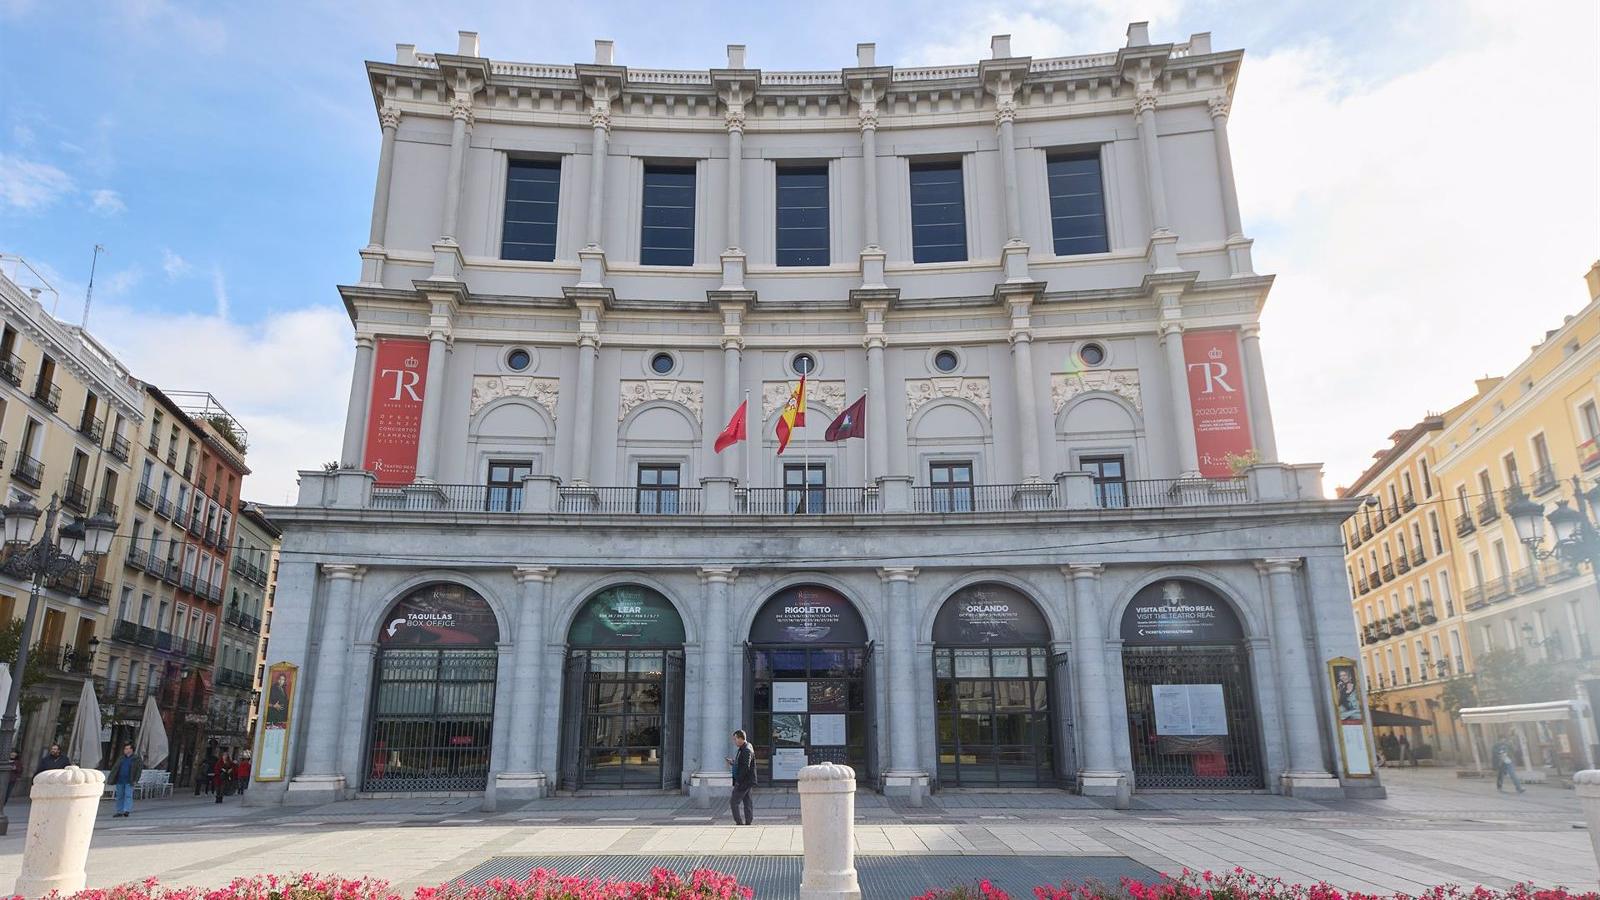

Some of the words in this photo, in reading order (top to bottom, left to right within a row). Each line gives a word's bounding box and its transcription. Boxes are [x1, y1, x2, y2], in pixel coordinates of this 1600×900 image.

[618, 606, 641, 614] LEAR
[784, 606, 832, 614] RIGOLETTO
[966, 605, 1009, 613] ORLANDO
